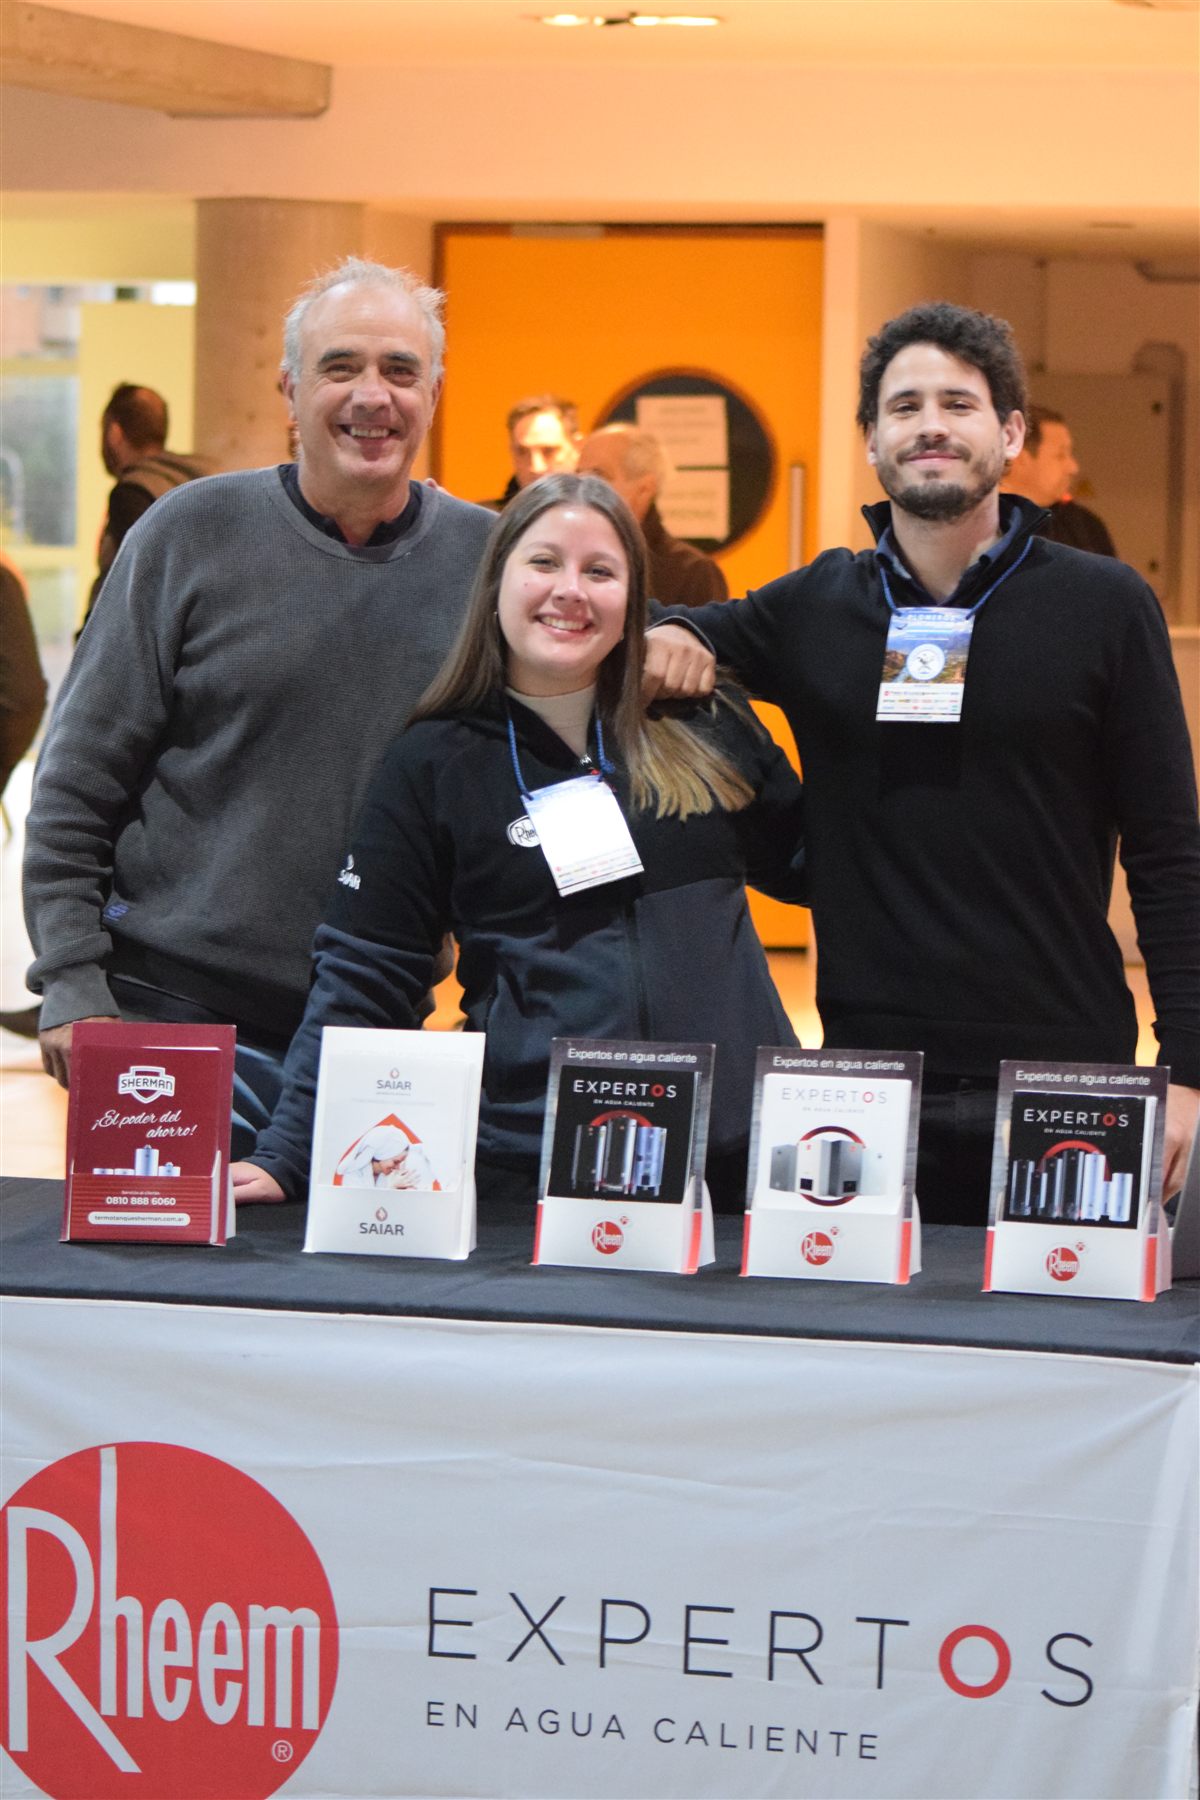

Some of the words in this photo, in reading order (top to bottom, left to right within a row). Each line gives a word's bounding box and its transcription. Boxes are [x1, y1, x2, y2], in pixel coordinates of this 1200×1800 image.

[567, 1048, 613, 1061] Expertos
[614, 1052, 628, 1060] en
[629, 1053, 656, 1063] agua
[657, 1053, 698, 1063] caliente
[772, 1056, 818, 1069] Expertos
[820, 1060, 834, 1068] en
[836, 1061, 863, 1071] agua
[864, 1060, 906, 1071] caliente
[121, 1078, 173, 1091] SHERMAN
[376, 1079, 412, 1091] SAIAR
[1015, 1070, 1062, 1083] Expertos
[1064, 1075, 1078, 1083] en
[1079, 1075, 1107, 1085] agua
[1108, 1075, 1151, 1085] caliente
[573, 1079, 677, 1098] EXPERTOS
[781, 1087, 888, 1105] EXPERTOS
[91, 1109, 120, 1131] ¡El
[119, 1112, 158, 1128] poder
[159, 1110, 182, 1123] del
[1023, 1108, 1130, 1128] EXPERTOS
[146, 1124, 198, 1138] ahorro!
[106, 1196, 129, 1205] 0810
[130, 1197, 150, 1206] 888
[151, 1197, 177, 1206] 6060
[359, 1222, 404, 1236] SAIAR
[7, 1446, 321, 1773] Rheem
[428, 1587, 1094, 1707] EXPERTOS
[426, 1701, 477, 1728] EN
[505, 1707, 626, 1740] AGUA
[653, 1718, 878, 1760] CALIENTE
